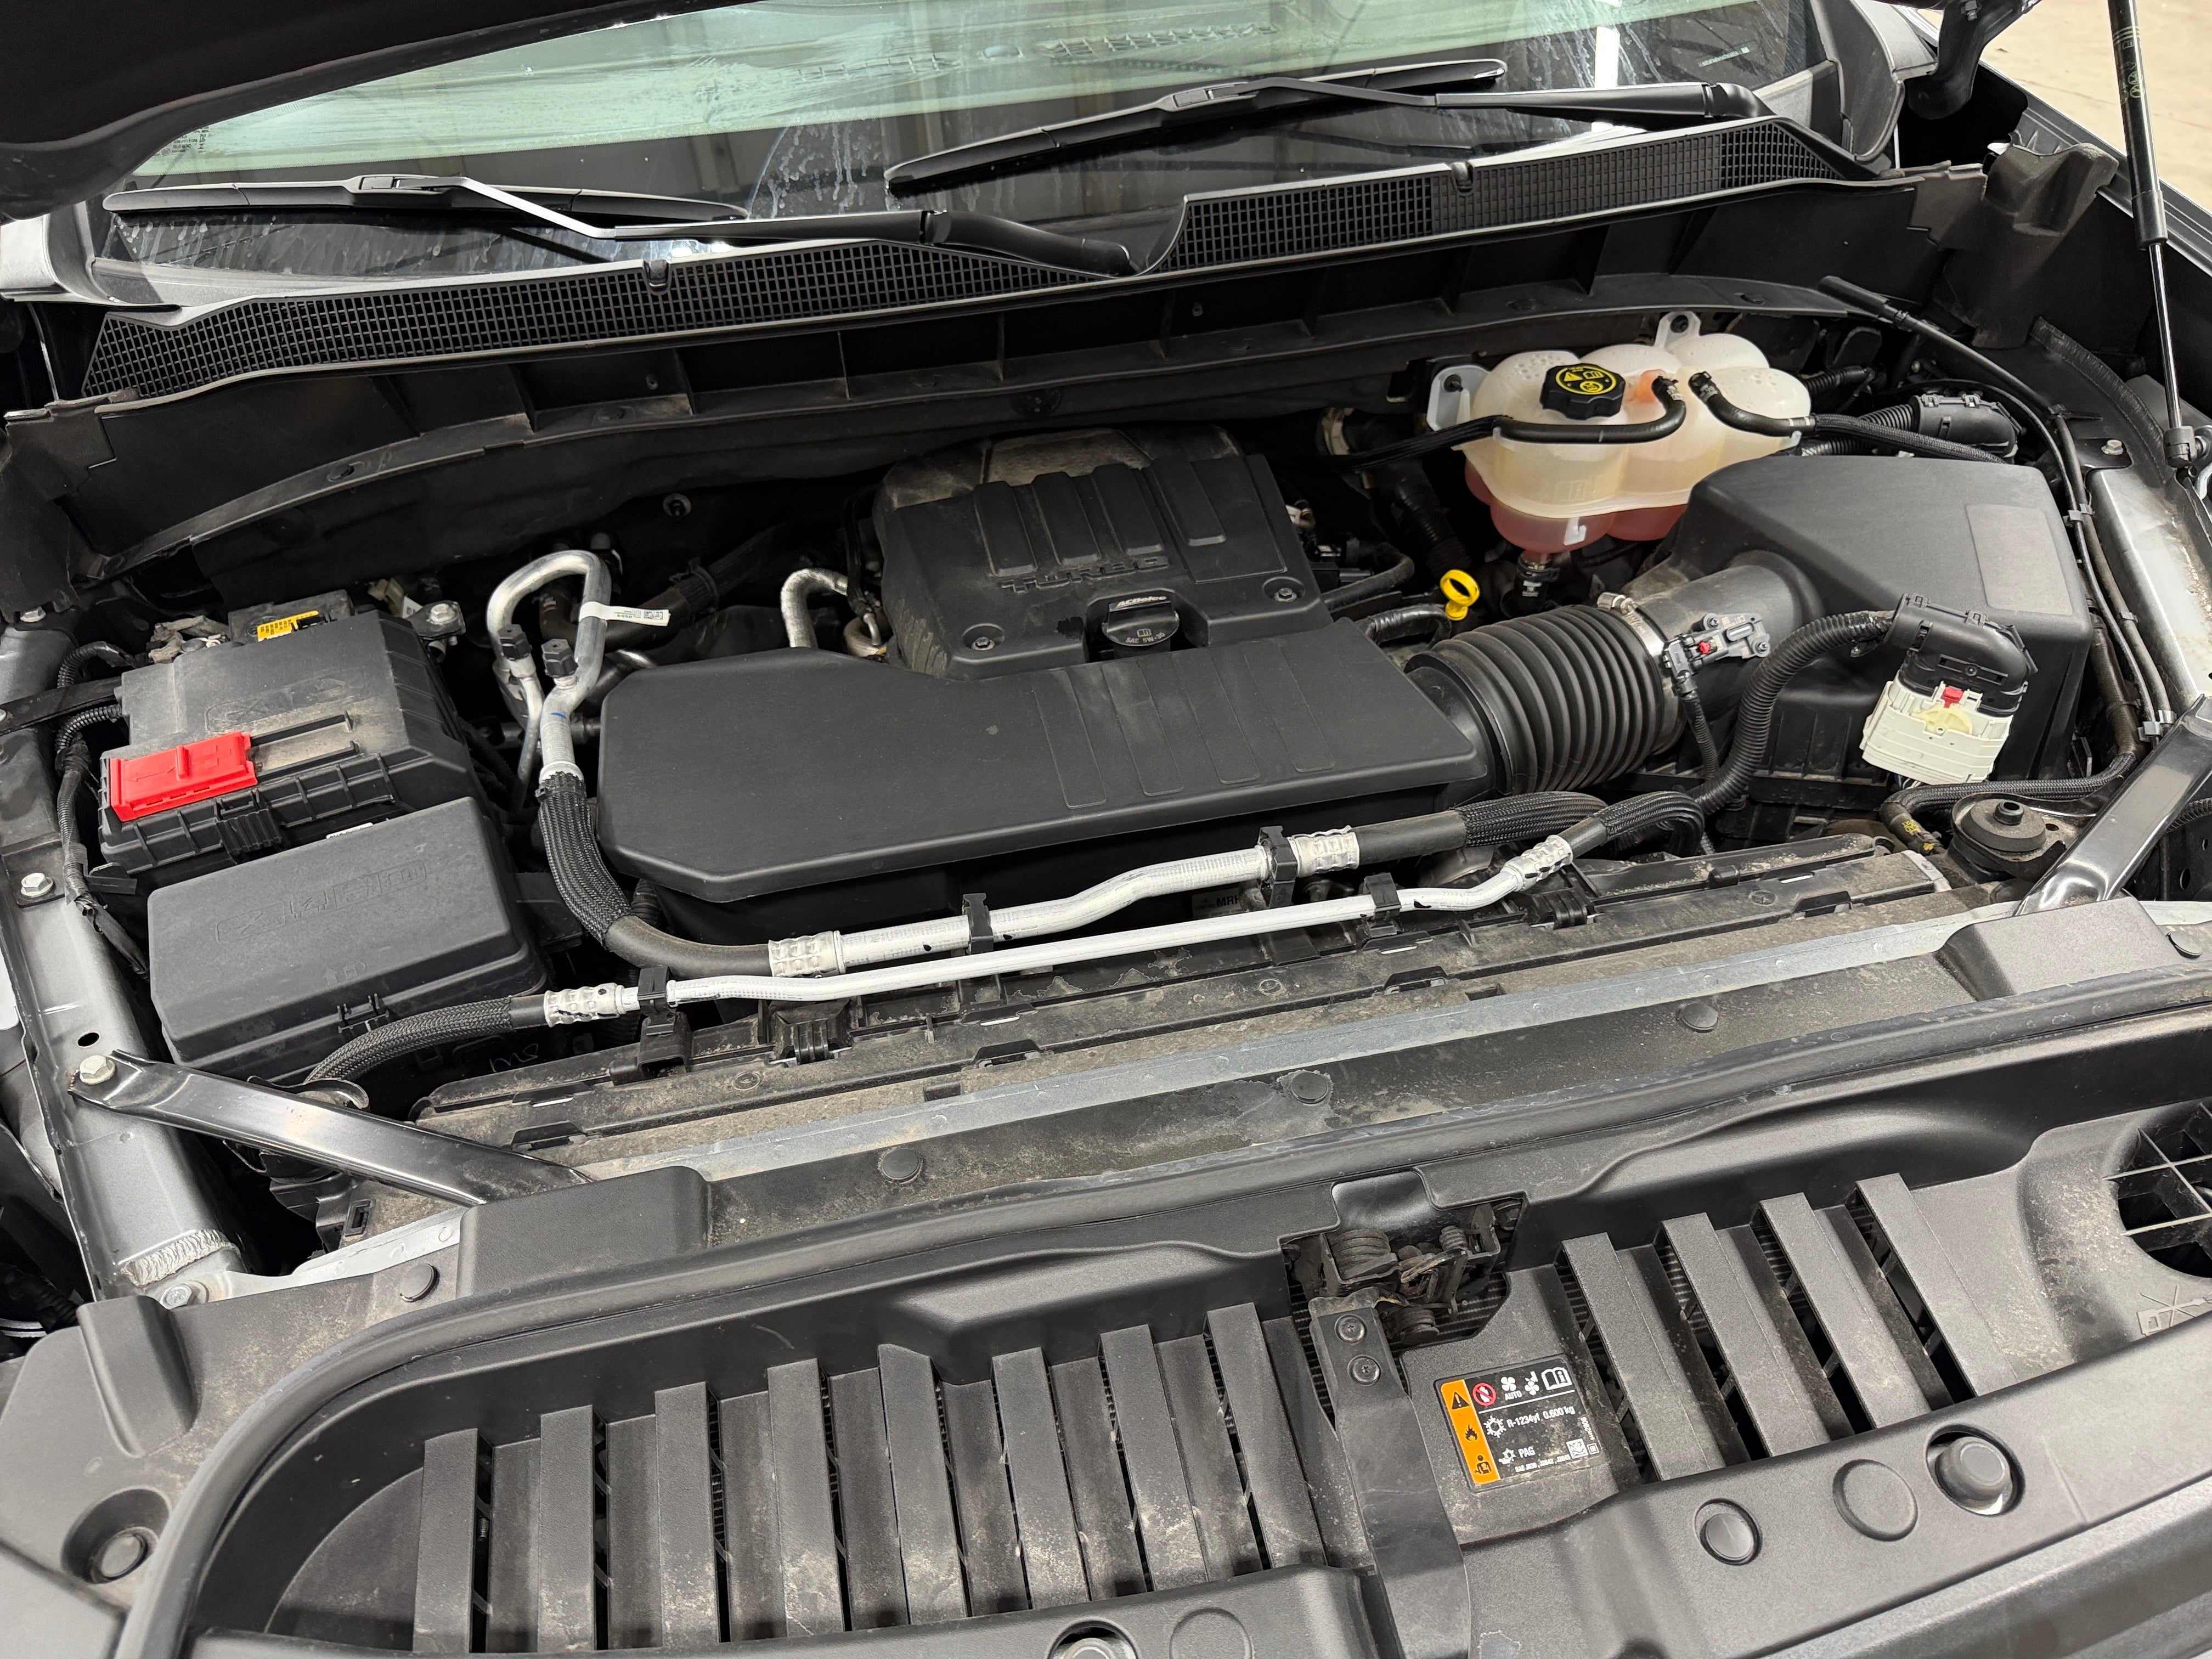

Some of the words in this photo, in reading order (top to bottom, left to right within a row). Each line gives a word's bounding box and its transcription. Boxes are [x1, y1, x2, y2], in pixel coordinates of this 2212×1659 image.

[1000, 556, 1170, 594] TURBO
[1115, 596, 1167, 609] ACDelco
[1142, 632, 1166, 643] 5W-30
[1504, 1390, 1522, 1401] AUTO
[1506, 1412, 1541, 1428] R-1234yf
[1542, 1407, 1564, 1419] 0.600
[1563, 1406, 1576, 1415] kg
[1517, 1446, 1536, 1458] PAG
[1514, 1464, 1526, 1472] SAE
